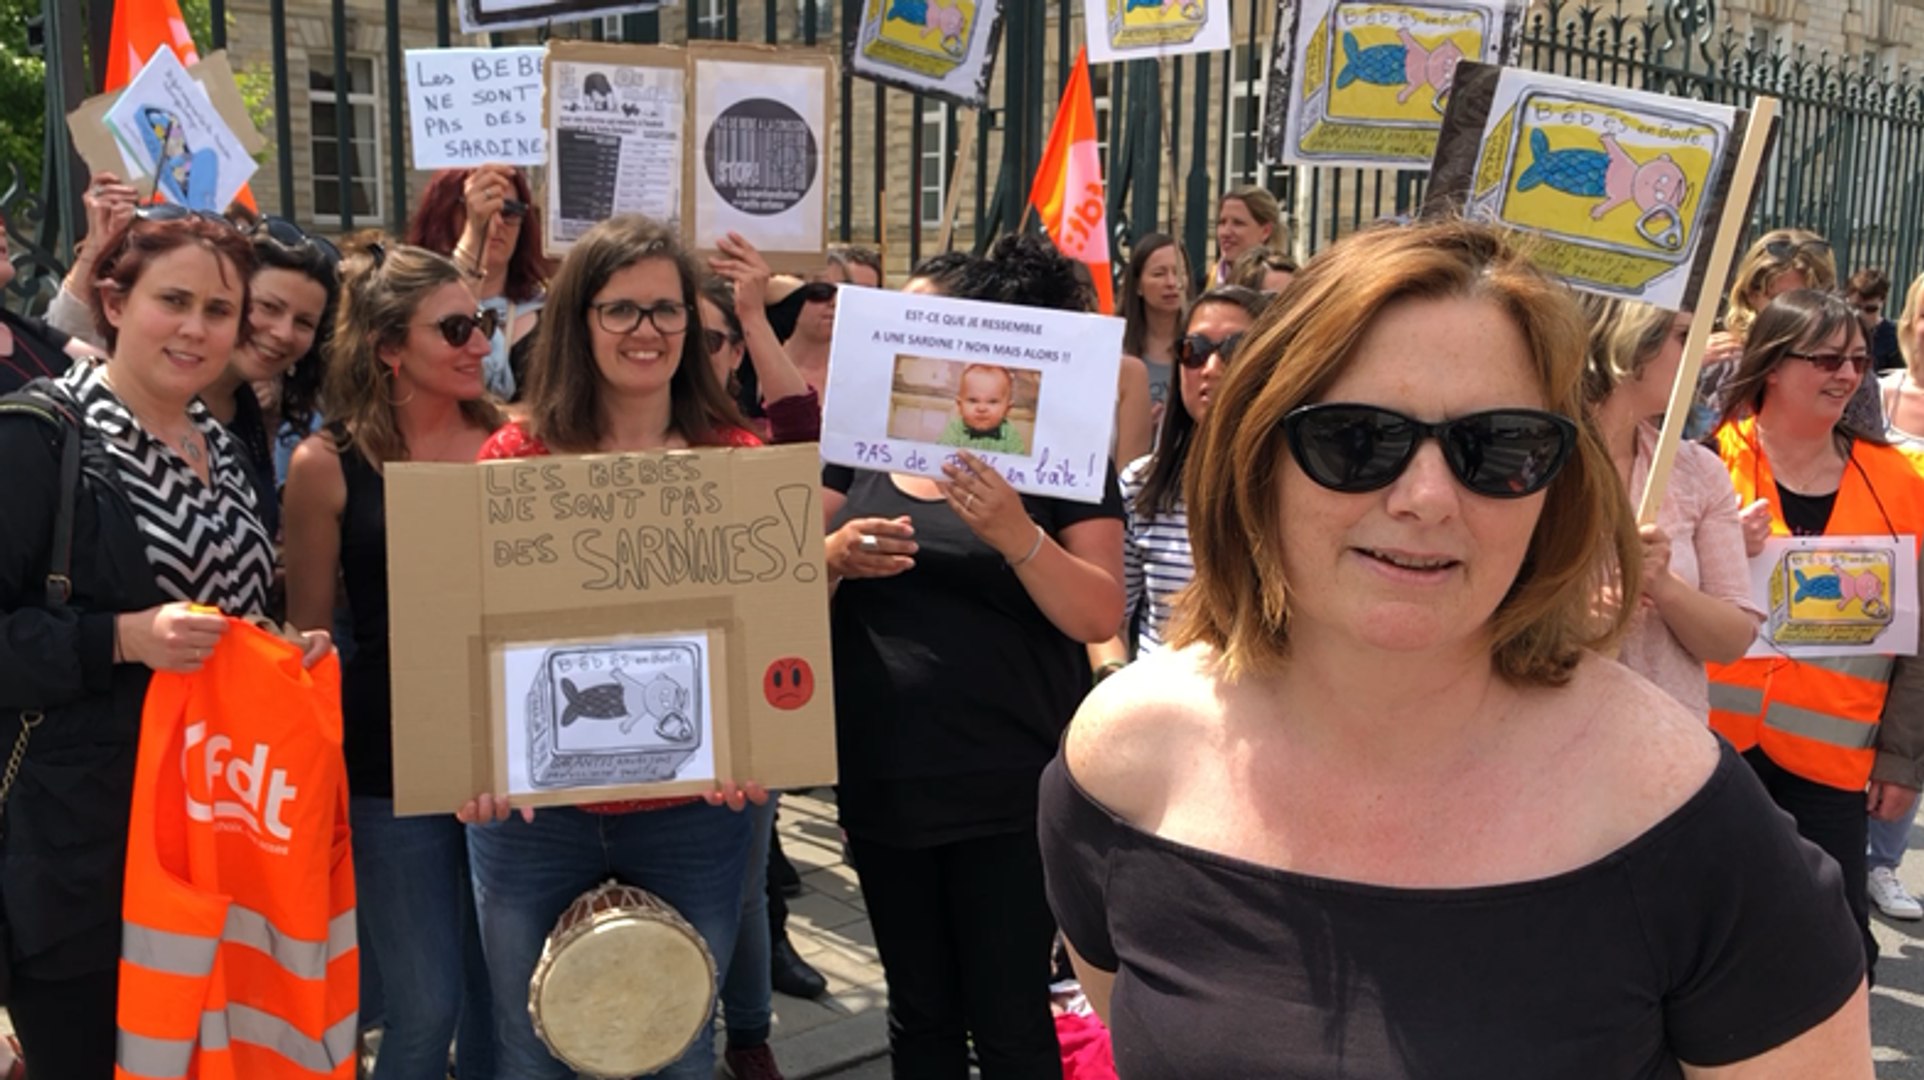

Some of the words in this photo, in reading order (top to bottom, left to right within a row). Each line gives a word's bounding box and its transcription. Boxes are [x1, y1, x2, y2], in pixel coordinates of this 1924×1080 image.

[417, 61, 455, 87] Les
[423, 94, 454, 111] NE
[471, 84, 539, 106] SONT
[424, 116, 463, 137] PAS
[485, 110, 526, 127] DES
[905, 309, 940, 324] EST-CE
[942, 313, 965, 327] QUE
[967, 316, 978, 328] JE
[981, 318, 1043, 336] RESSEMBLE
[872, 330, 881, 341] A
[883, 331, 905, 345] UNE
[907, 334, 954, 350] SARDINE
[957, 338, 964, 351] ?
[965, 341, 990, 354] NON
[993, 343, 1021, 358] MAIS
[1023, 348, 1059, 362] ALORS
[485, 464, 566, 496] LES
[854, 441, 892, 464] PAS
[904, 451, 929, 473] de
[1006, 466, 1026, 485] en
[1085, 451, 1097, 488] !
[487, 497, 537, 525] NE
[551, 489, 646, 522] SONT
[659, 482, 722, 517] PAS
[493, 533, 558, 568] DES
